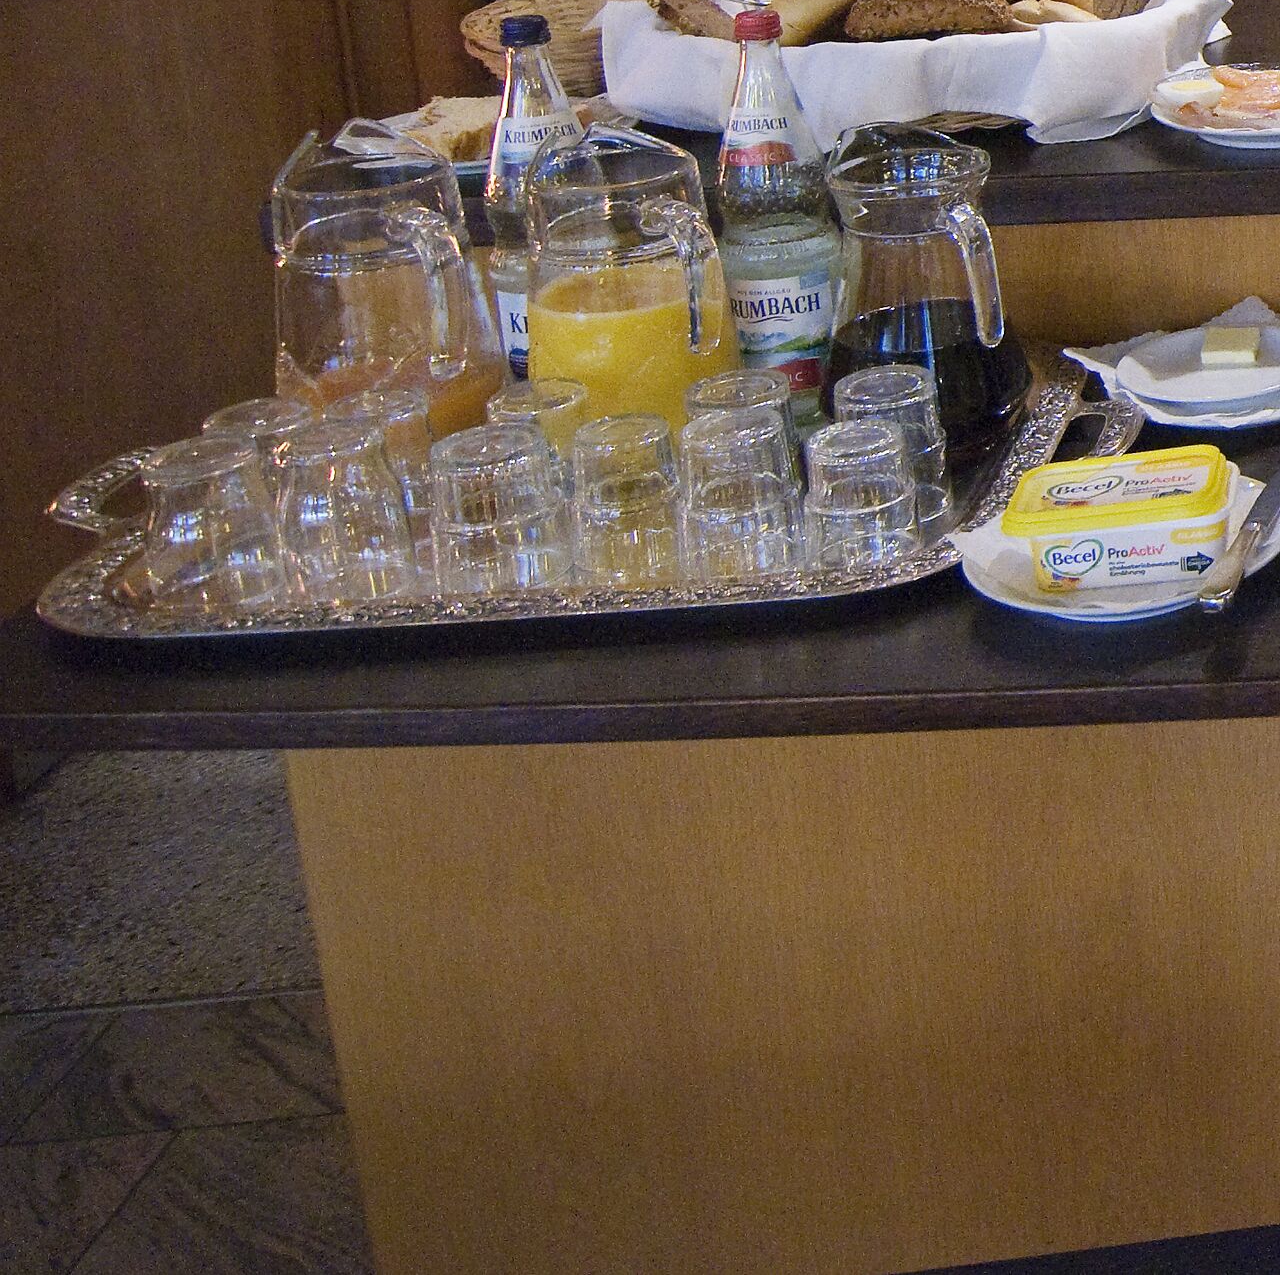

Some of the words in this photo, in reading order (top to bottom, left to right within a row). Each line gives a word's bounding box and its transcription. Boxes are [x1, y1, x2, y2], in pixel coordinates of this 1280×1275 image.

[730, 291, 822, 320] RUMBACH
[1056, 480, 1114, 495] Becel
[1052, 547, 1097, 567] Becel
